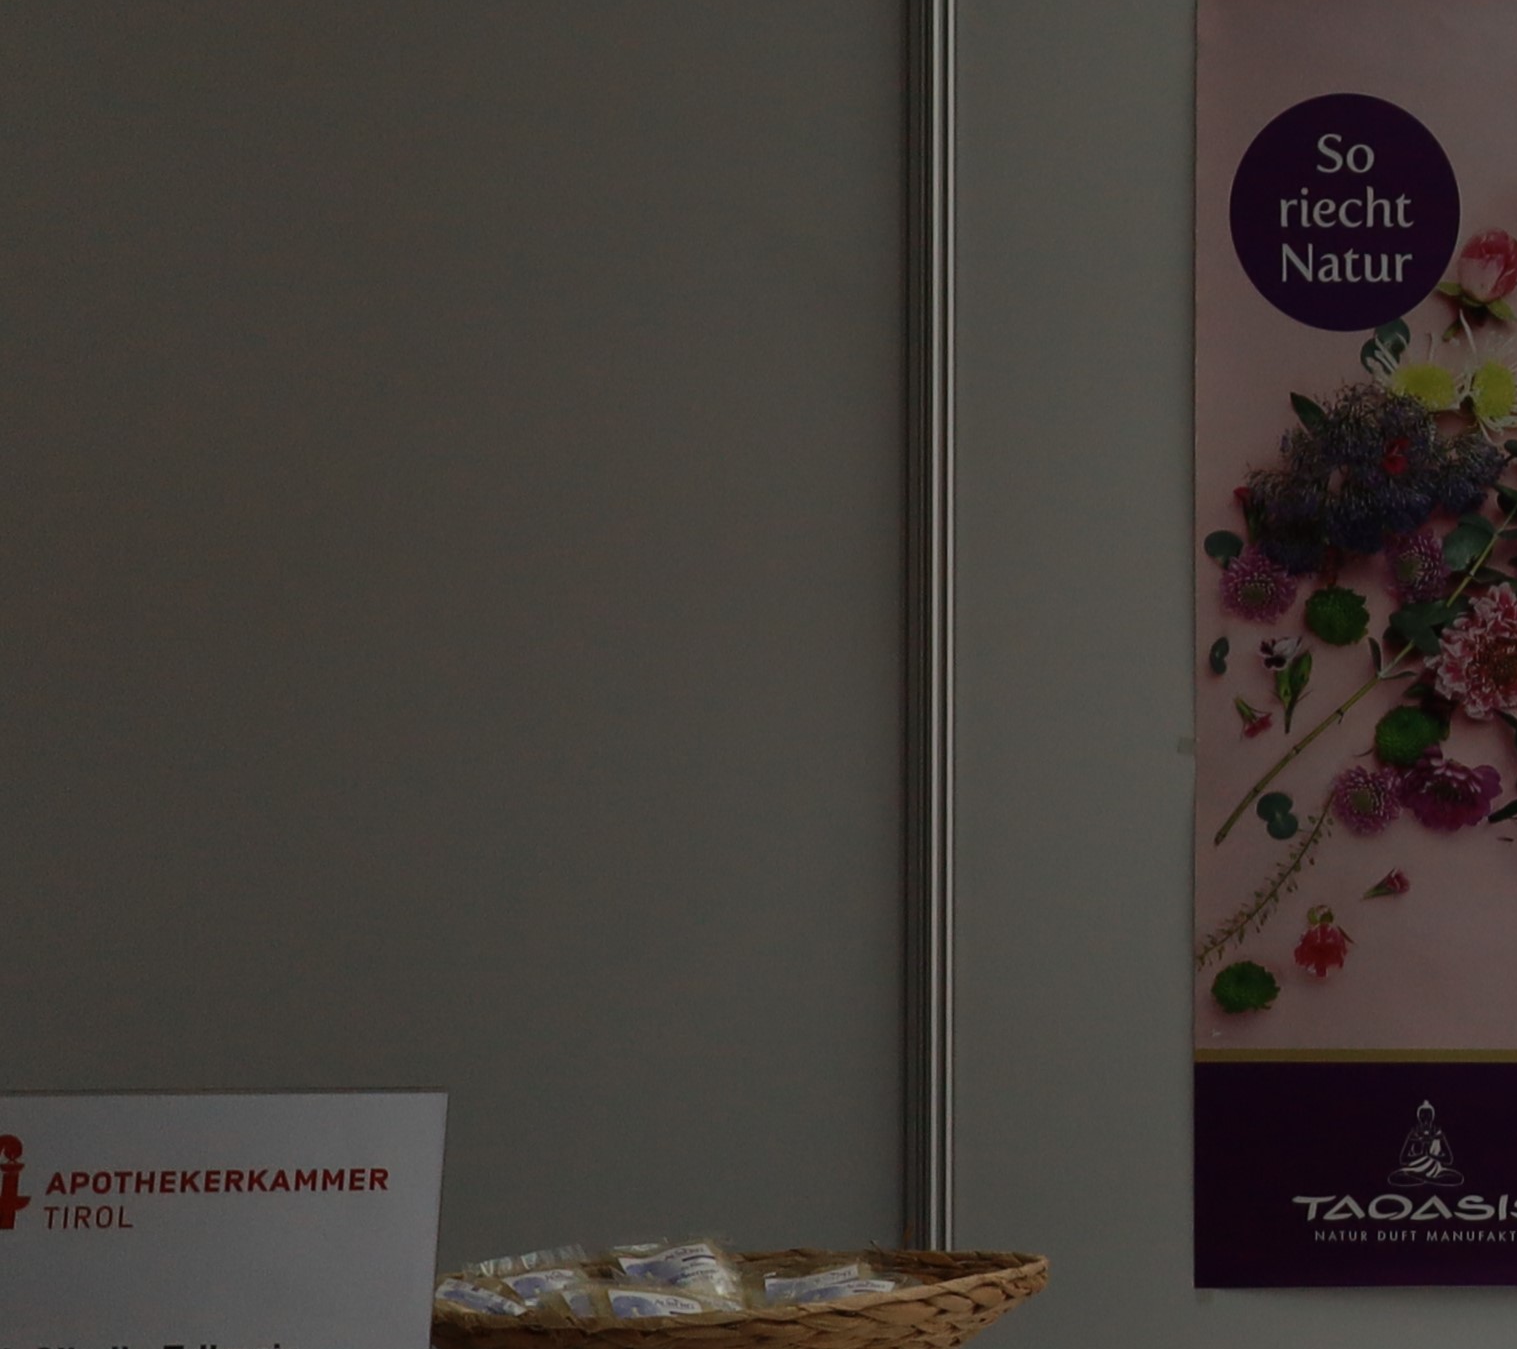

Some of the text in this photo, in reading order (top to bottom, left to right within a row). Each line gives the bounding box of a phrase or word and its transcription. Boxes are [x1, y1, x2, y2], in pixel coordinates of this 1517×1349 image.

[1317, 134, 1374, 173] So
[1281, 186, 1413, 228] riecht
[1282, 243, 1412, 282] Natur
[45, 1169, 388, 1196] APOTHEKERKAMMER
[44, 1206, 133, 1229] TIROL
[1315, 1231, 1367, 1241] NATUR
[1377, 1231, 1416, 1241] DUFT
